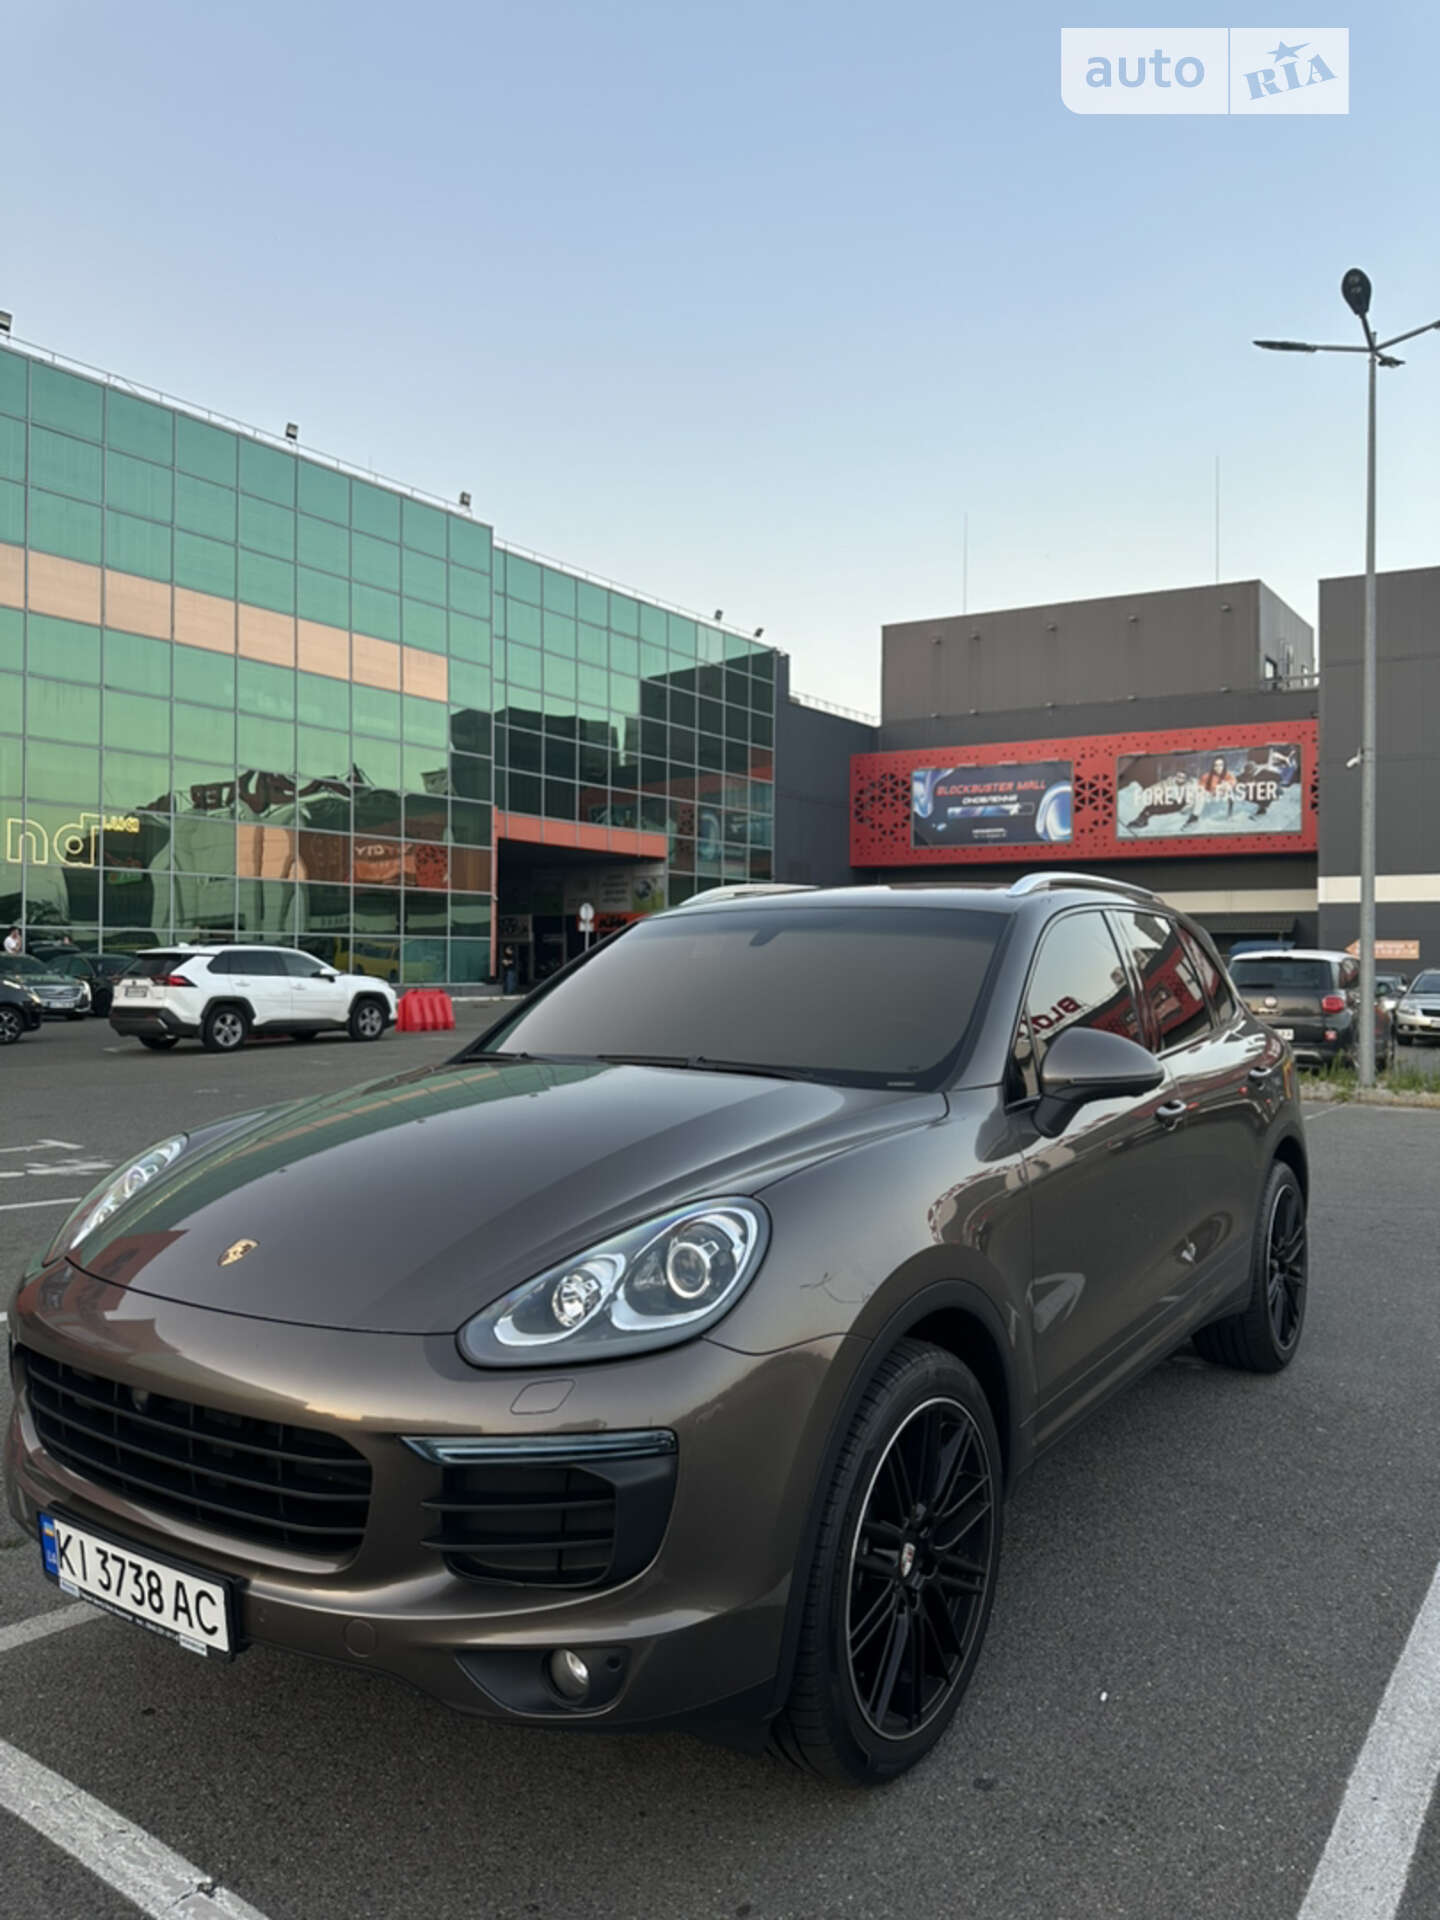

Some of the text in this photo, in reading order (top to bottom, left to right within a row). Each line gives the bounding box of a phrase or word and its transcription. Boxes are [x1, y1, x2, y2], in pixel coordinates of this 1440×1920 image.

[936, 779, 1045, 796] BLOCKBUSTER MALL
[96, 1547, 164, 1614] 3738
[174, 1580, 218, 1635] AC
